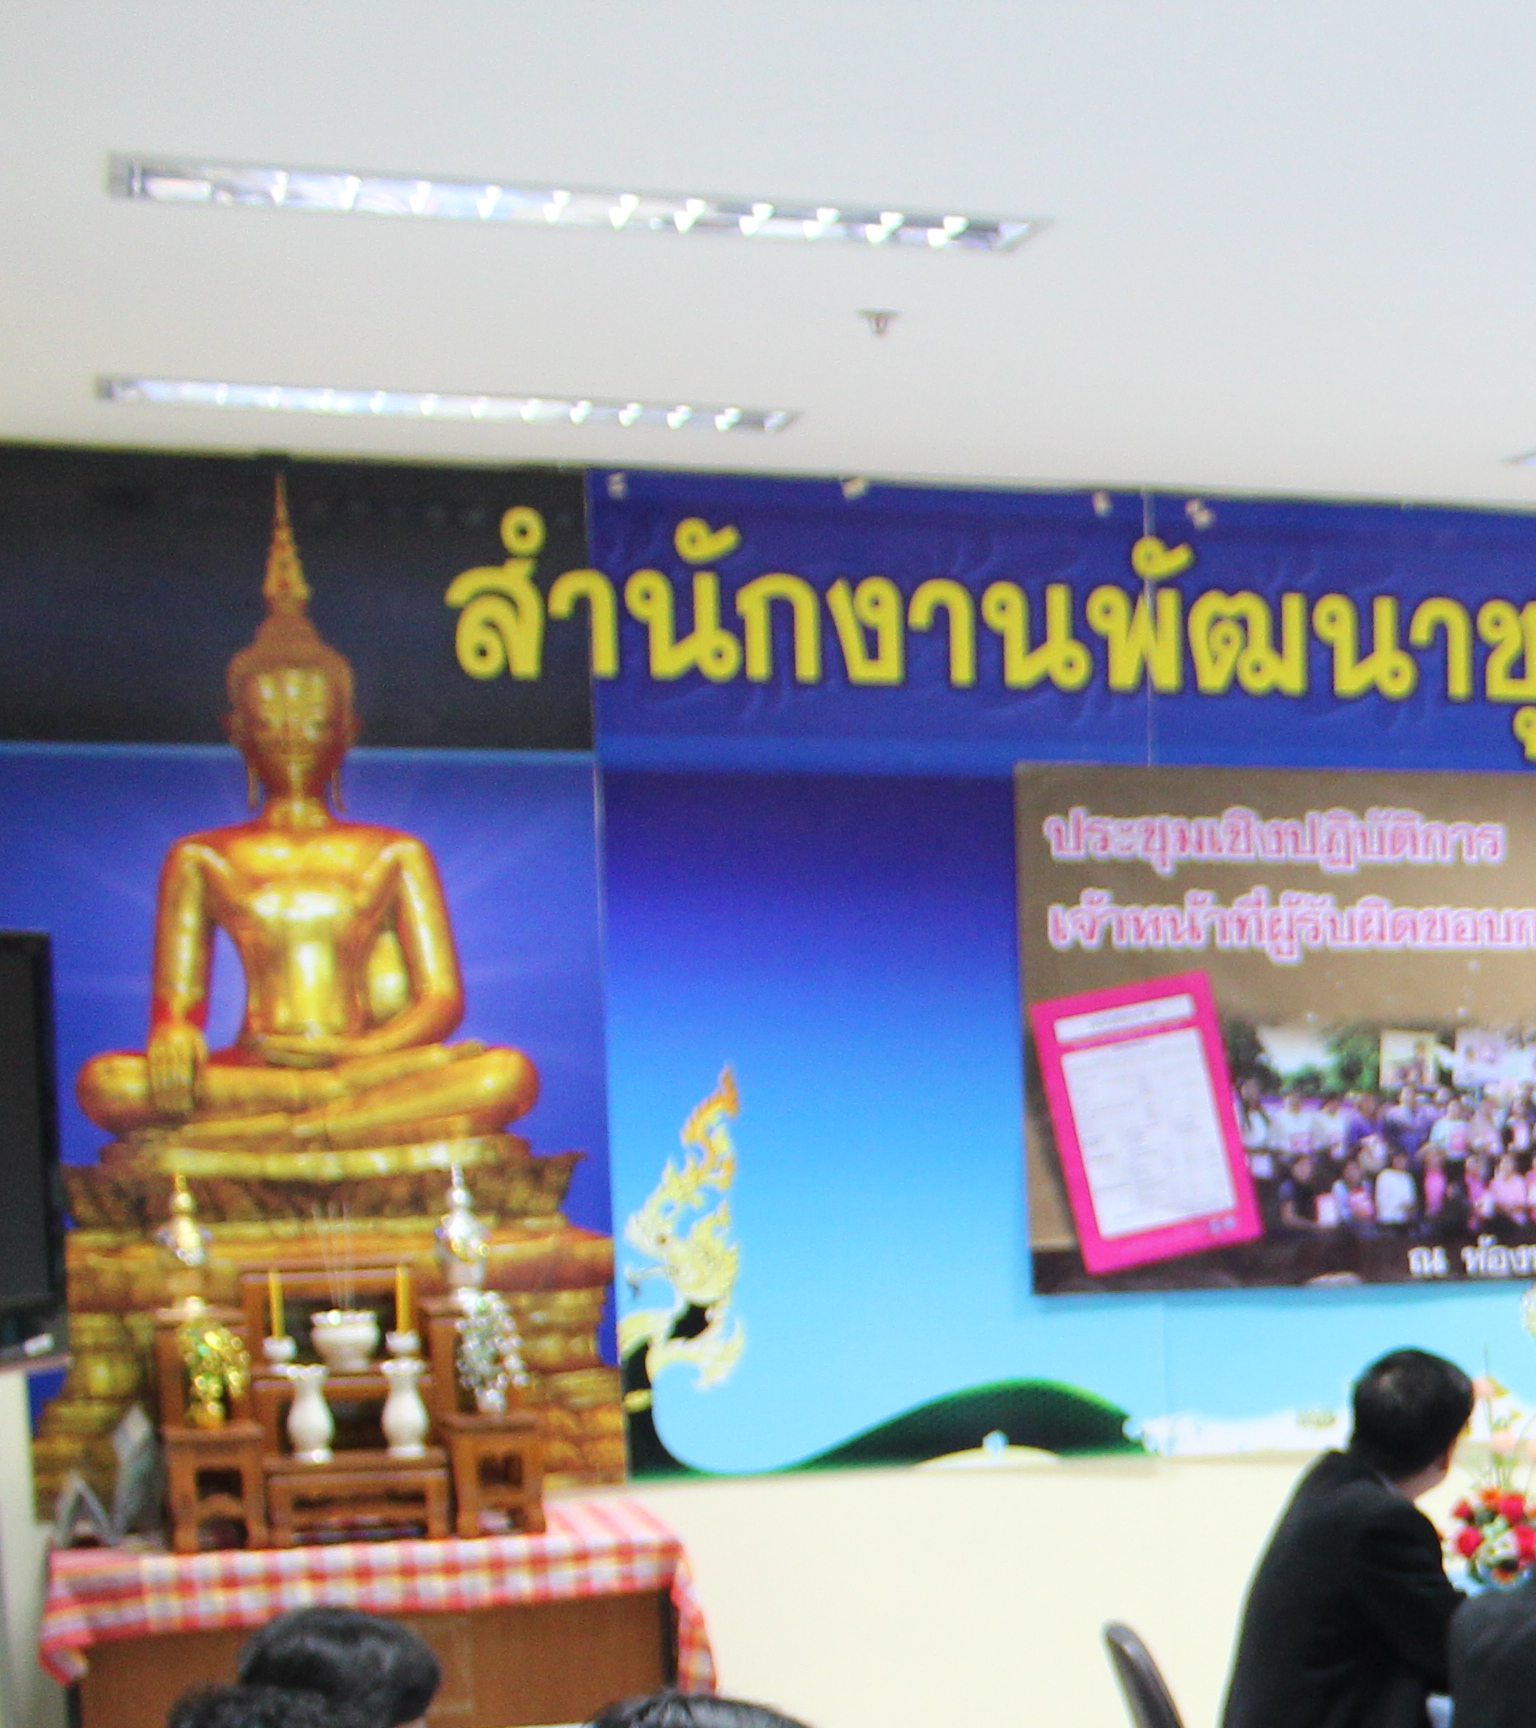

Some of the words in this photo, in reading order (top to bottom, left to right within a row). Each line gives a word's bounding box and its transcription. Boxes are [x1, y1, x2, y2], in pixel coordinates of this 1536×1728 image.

[1043, 805, 1506, 875] ประชุมเชิงปฏิบัติการ
